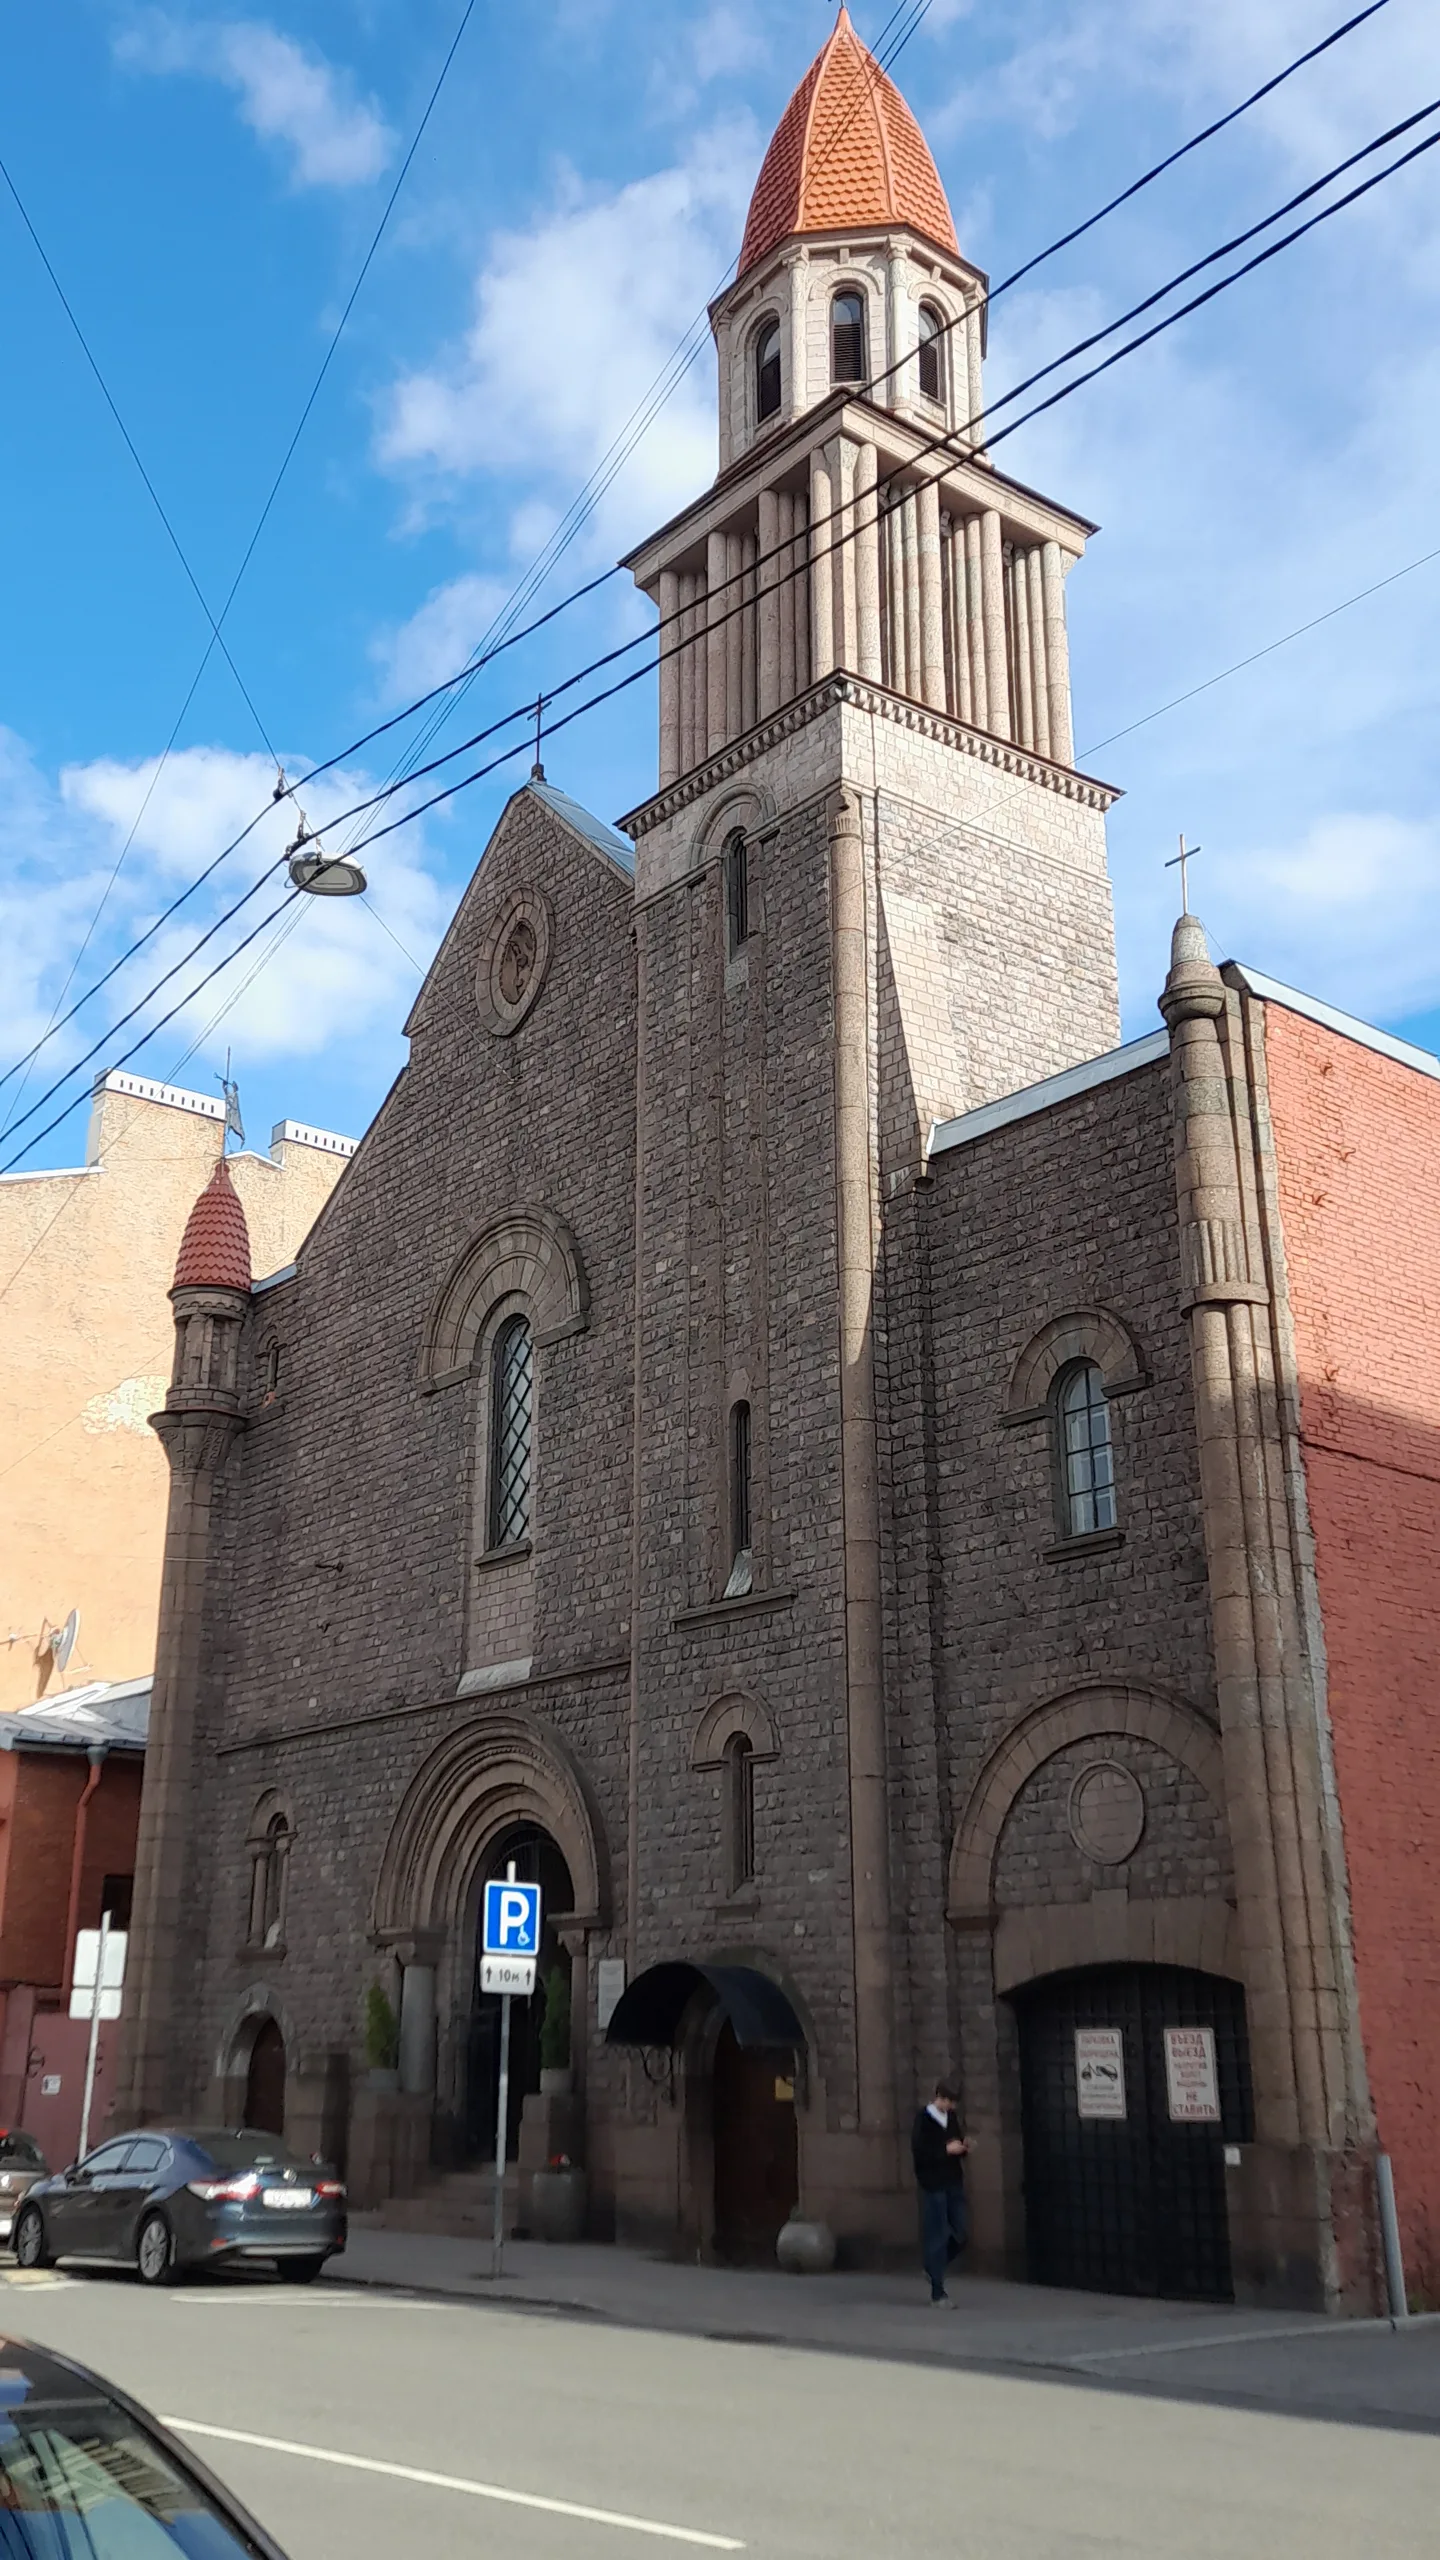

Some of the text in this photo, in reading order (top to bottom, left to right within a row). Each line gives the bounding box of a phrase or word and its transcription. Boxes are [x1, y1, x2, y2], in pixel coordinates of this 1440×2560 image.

[499, 1890, 530, 1946] P
[1170, 2033, 1204, 2046] ВЪЕЗД
[1172, 2046, 1206, 2058] ВЫЕЗД
[1185, 2091, 1198, 2102] НЕ
[1172, 2103, 1217, 2116] СТАВИТЬ
